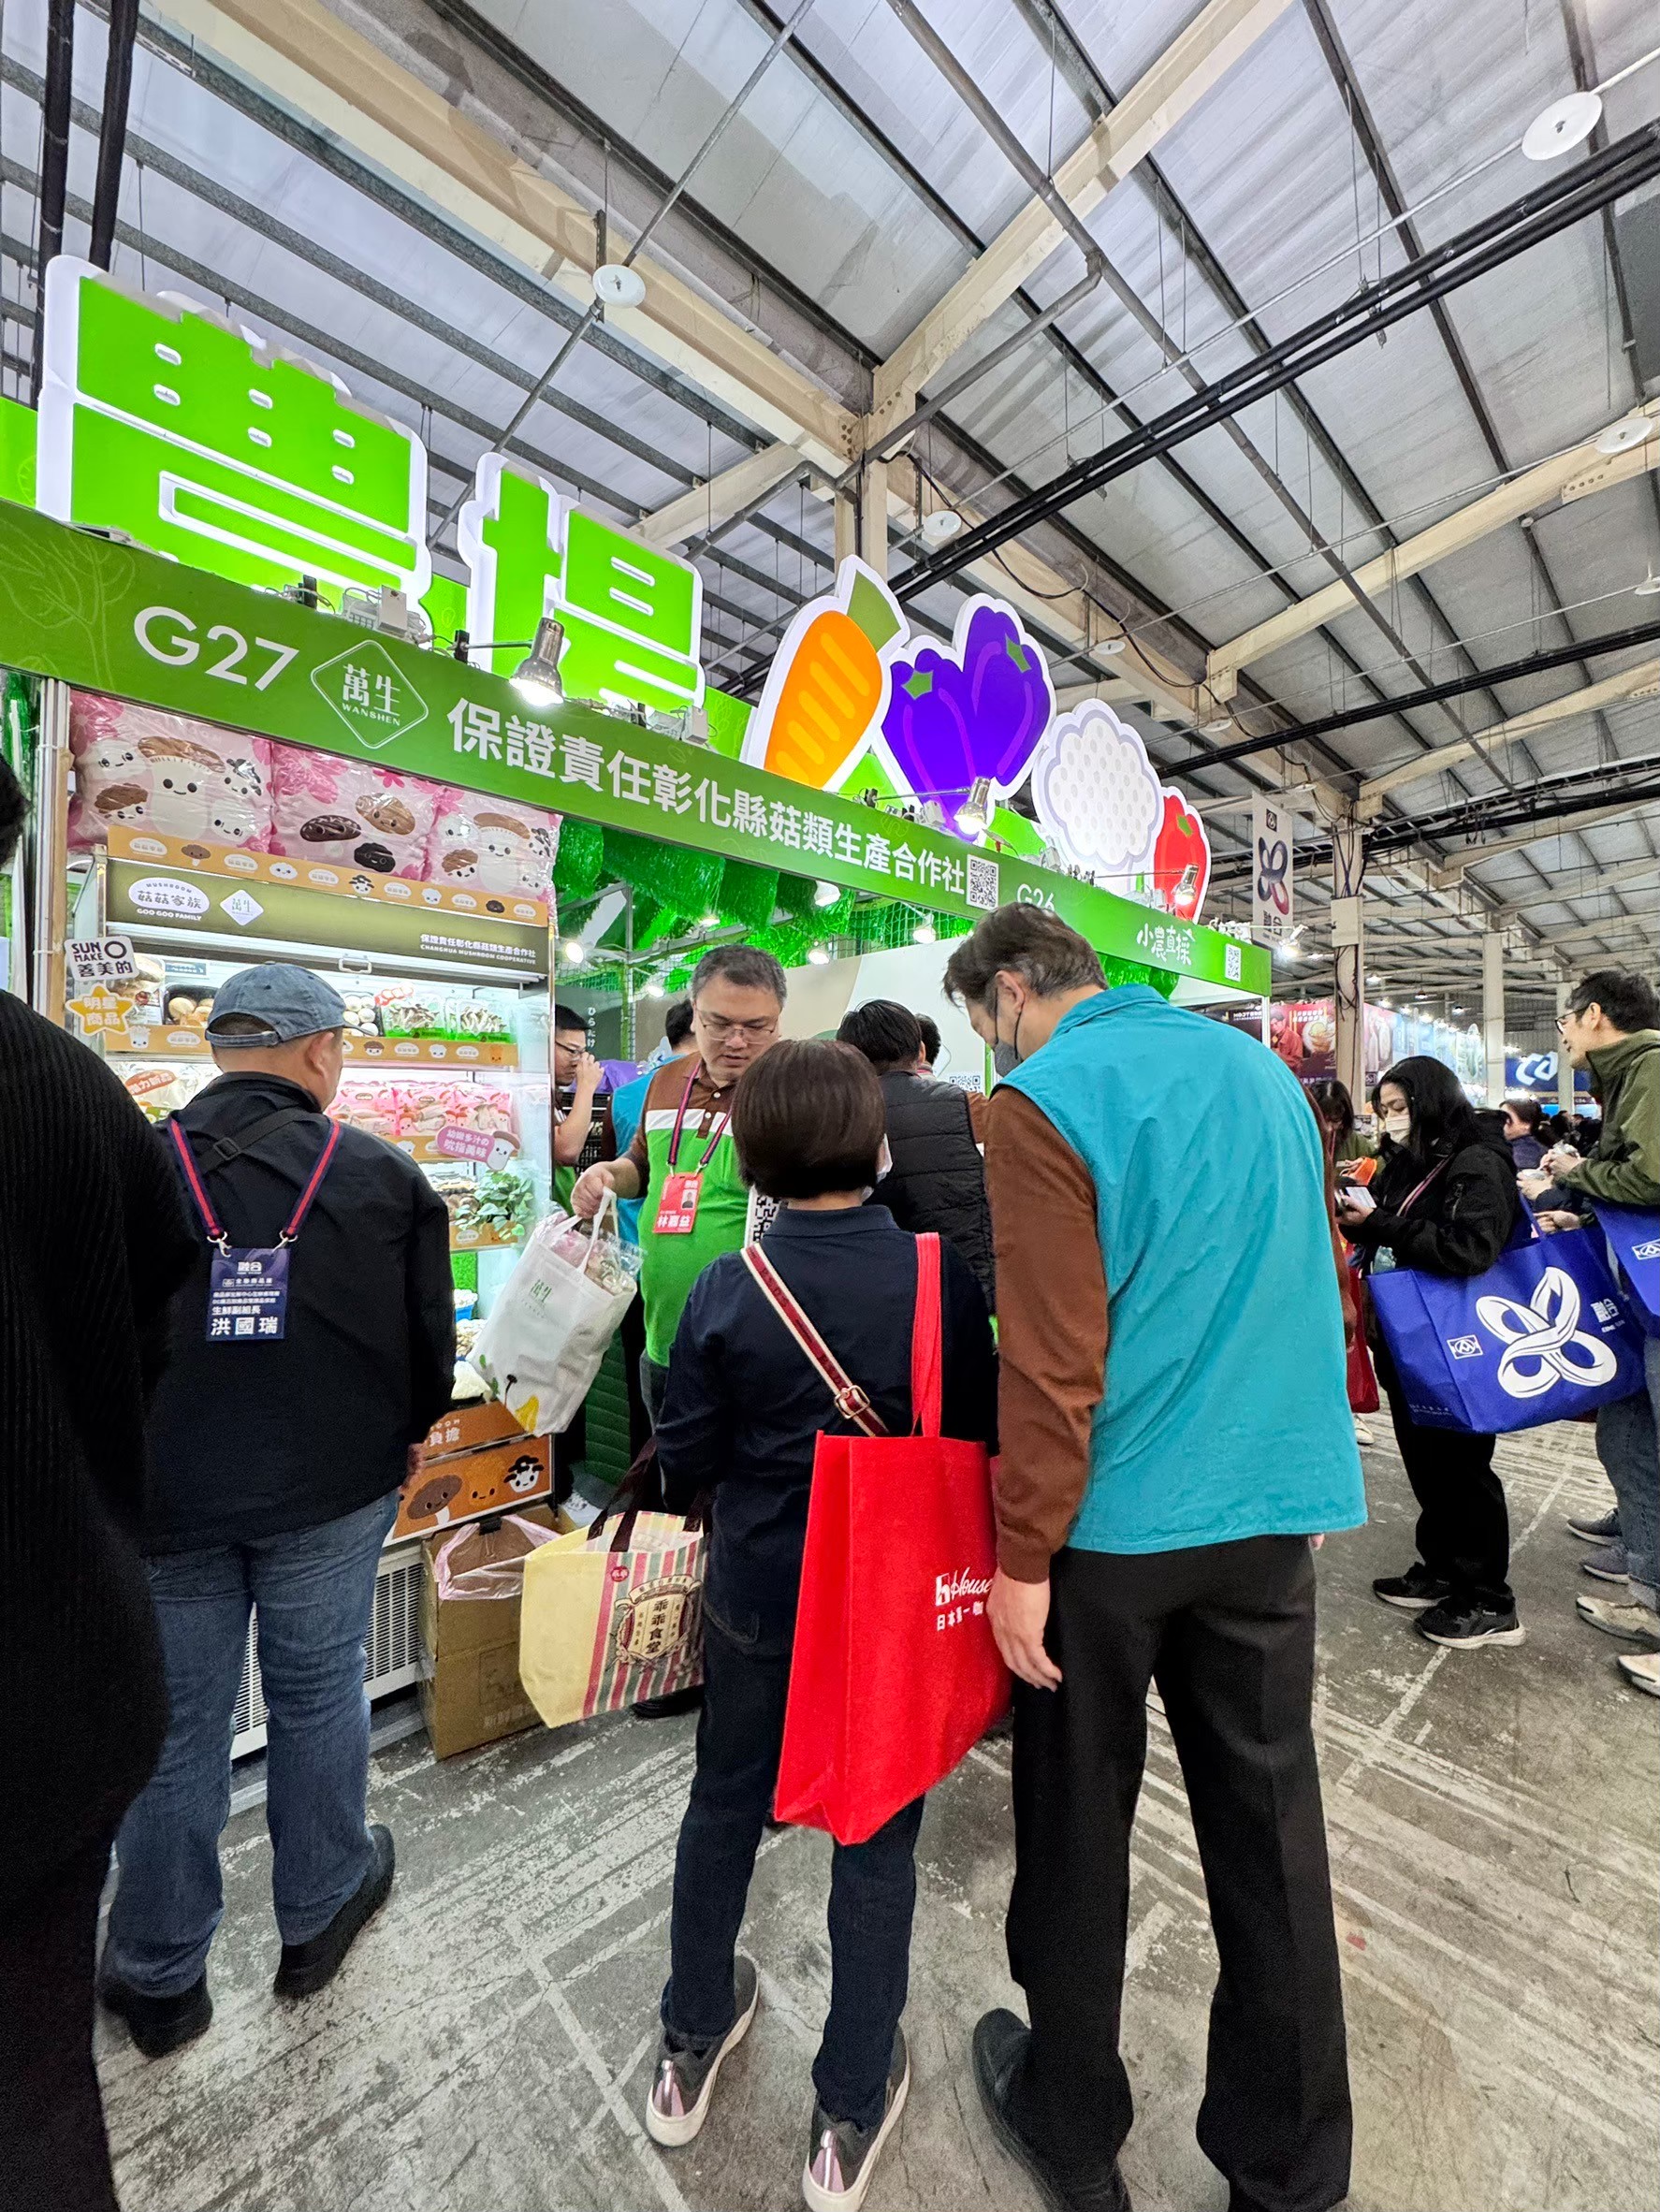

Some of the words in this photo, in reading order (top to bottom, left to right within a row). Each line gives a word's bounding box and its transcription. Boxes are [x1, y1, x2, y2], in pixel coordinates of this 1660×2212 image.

[134, 606, 299, 691] G27
[342, 663, 400, 717] 萬生
[342, 702, 400, 726] WANSHEN
[446, 697, 965, 895] 保證責任彰化縣菇類生產合作社
[146, 882, 193, 894] MUSHROOM
[138, 890, 202, 910] 菇菇家族
[137, 908, 155, 916] GOO
[156, 910, 174, 919] GOO
[175, 912, 202, 922] FAMILY
[71, 941, 102, 955] SUN
[420, 944, 458, 954] CHANGHUA
[459, 949, 496, 960] MUSHROOM
[1136, 923, 1193, 966] 小農直採
[74, 951, 105, 963] MAKE
[77, 960, 134, 978] 善美的
[85, 1012, 120, 1026] 商品
[211, 1317, 278, 1336] 洪國瑞
[646, 1598, 669, 1654] 乖乖食堂
